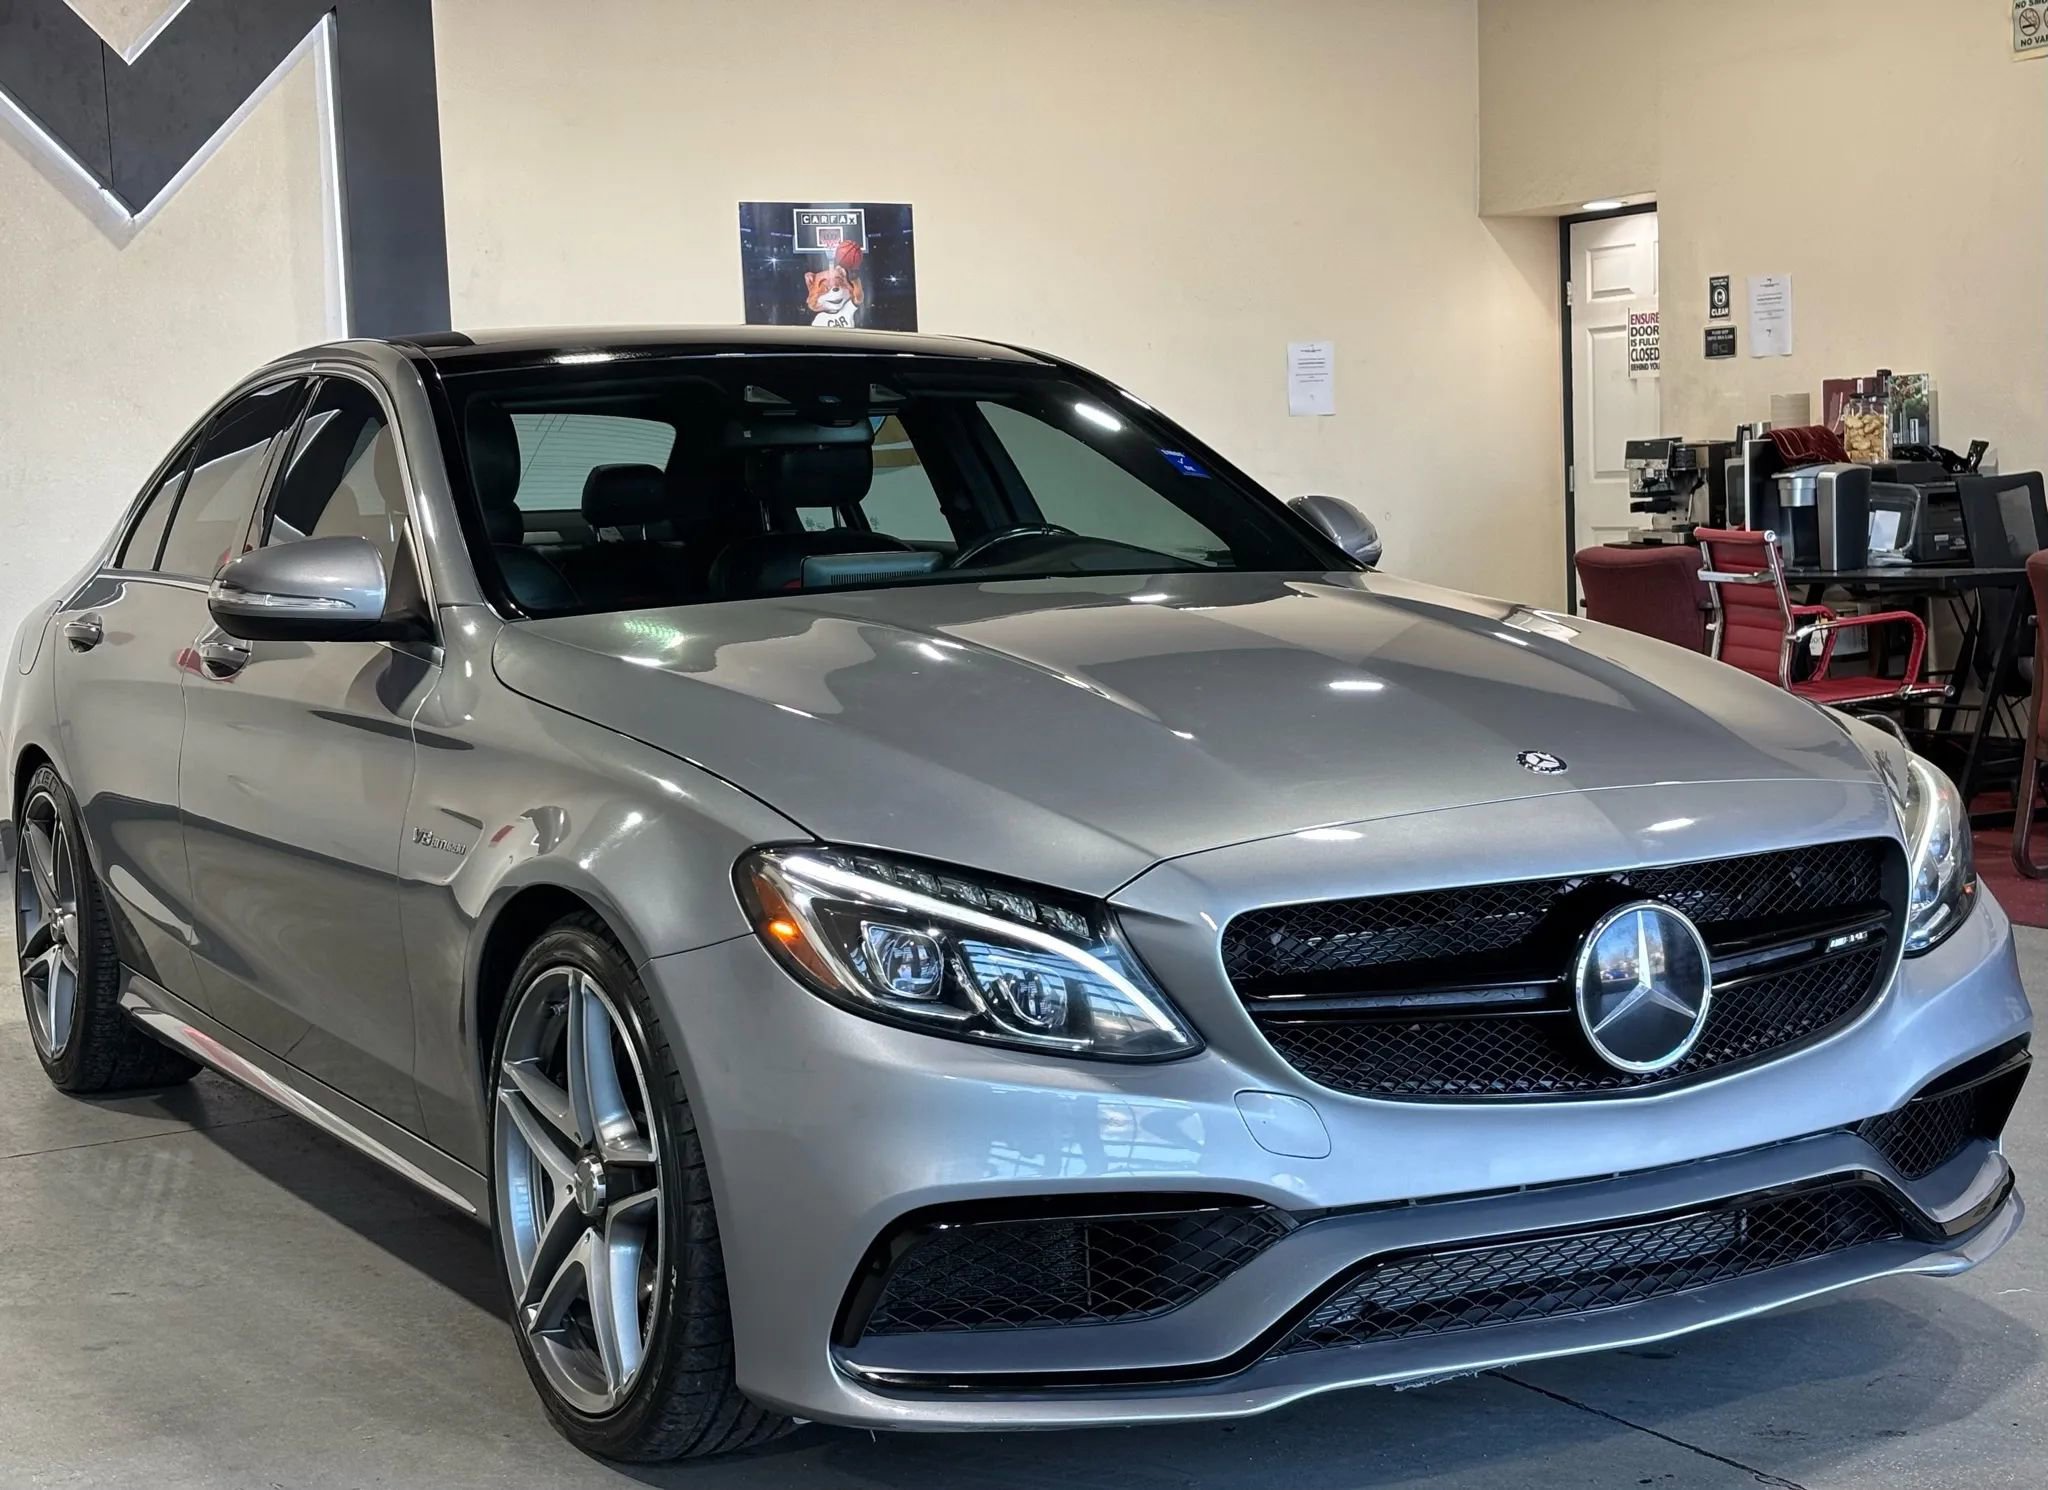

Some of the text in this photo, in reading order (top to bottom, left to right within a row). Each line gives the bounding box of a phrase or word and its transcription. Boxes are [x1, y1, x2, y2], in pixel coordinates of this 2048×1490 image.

[2015, 1, 2026, 9] NO
[2021, 38, 2032, 47] NO
[802, 214, 857, 225] CARFAX
[1630, 312, 1660, 325] ENSURE
[1630, 325, 1660, 337] DOOR
[1631, 337, 1660, 347] IS FULLY
[1630, 347, 1660, 362] CLOSED
[1630, 362, 1650, 371] BEHIND
